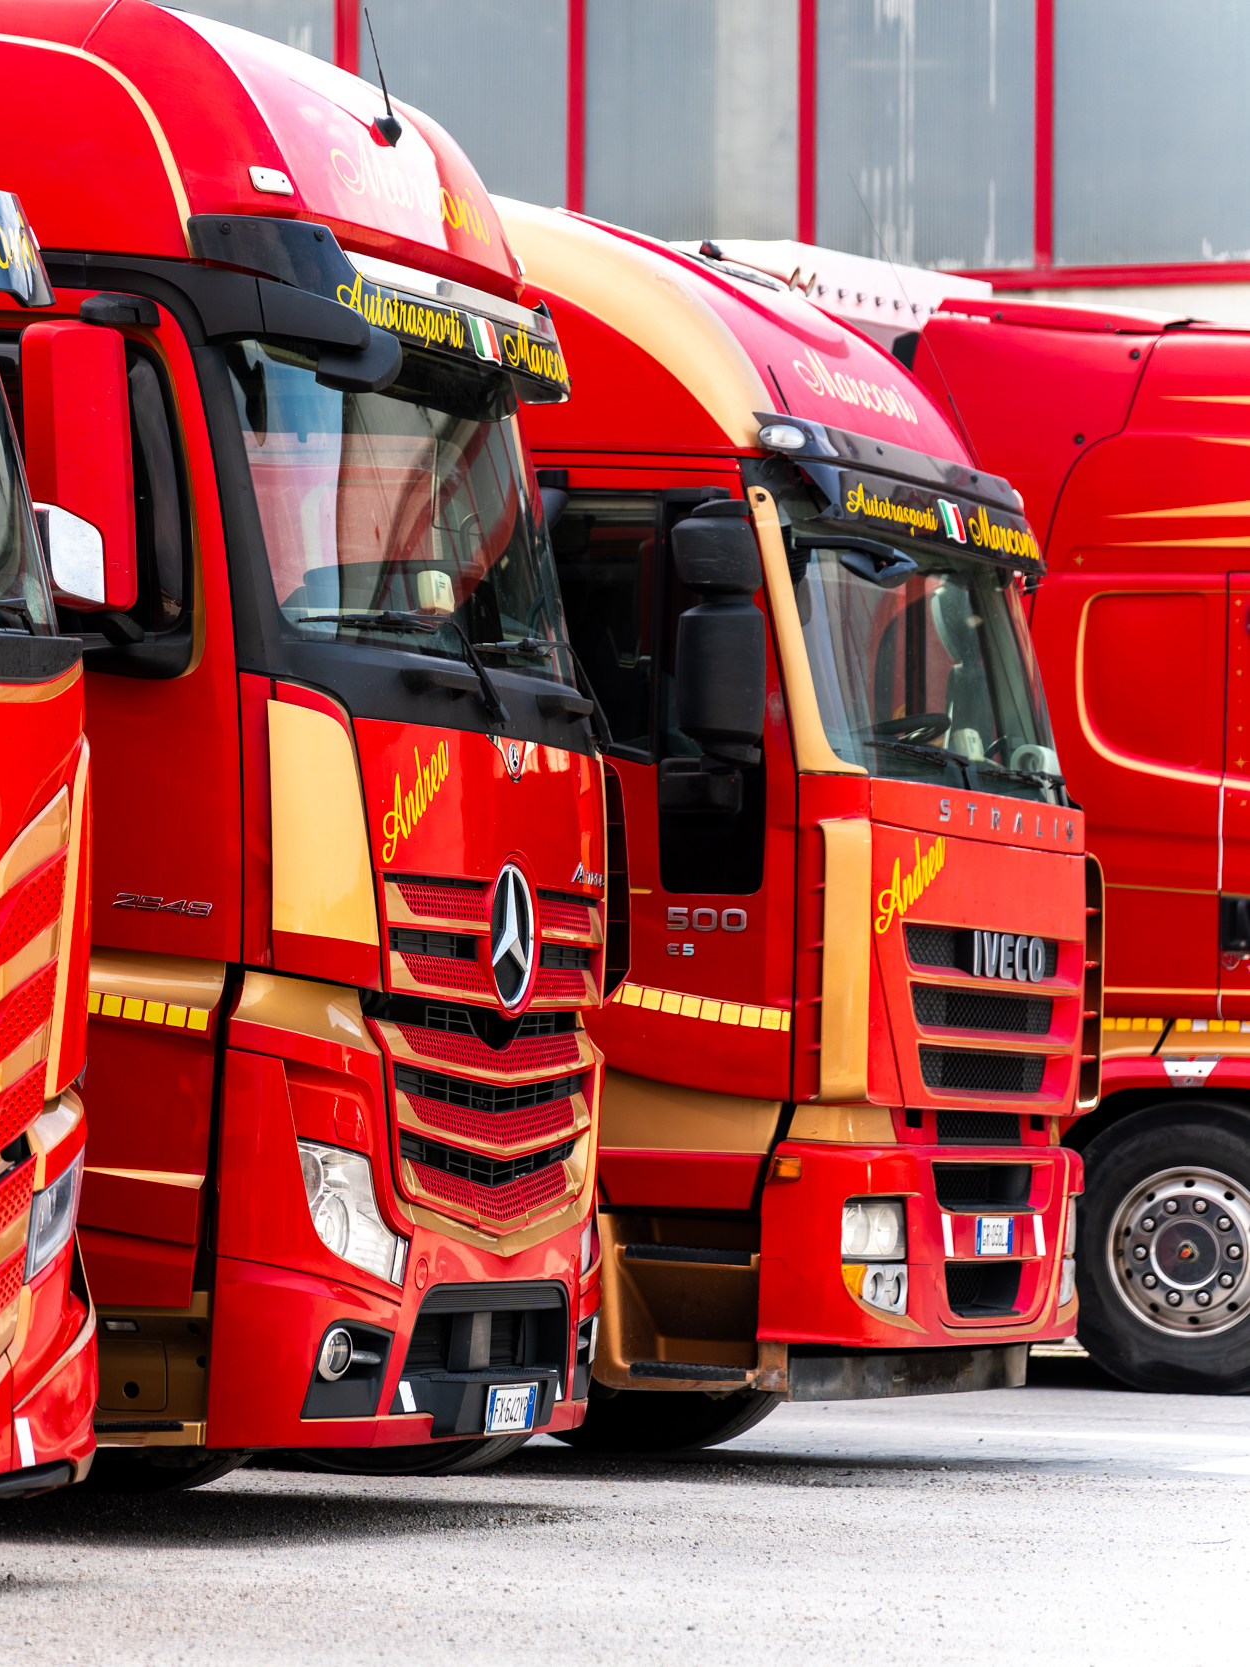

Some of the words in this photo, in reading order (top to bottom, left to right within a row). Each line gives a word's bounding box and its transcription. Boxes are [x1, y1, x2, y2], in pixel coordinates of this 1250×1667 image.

[330, 133, 490, 246] Marconi
[337, 271, 464, 349] Autotrasporti
[792, 347, 918, 424] Marconi
[846, 483, 938, 537] Autotrasporti
[968, 506, 1041, 560] Marconi
[382, 739, 449, 864] Andrea
[939, 798, 1074, 842] STRALIS
[111, 892, 213, 918] 2548
[666, 906, 748, 932] 500
[874, 836, 946, 934] Andrea
[666, 943, 695, 956] E5
[972, 930, 1046, 983] IVECO
